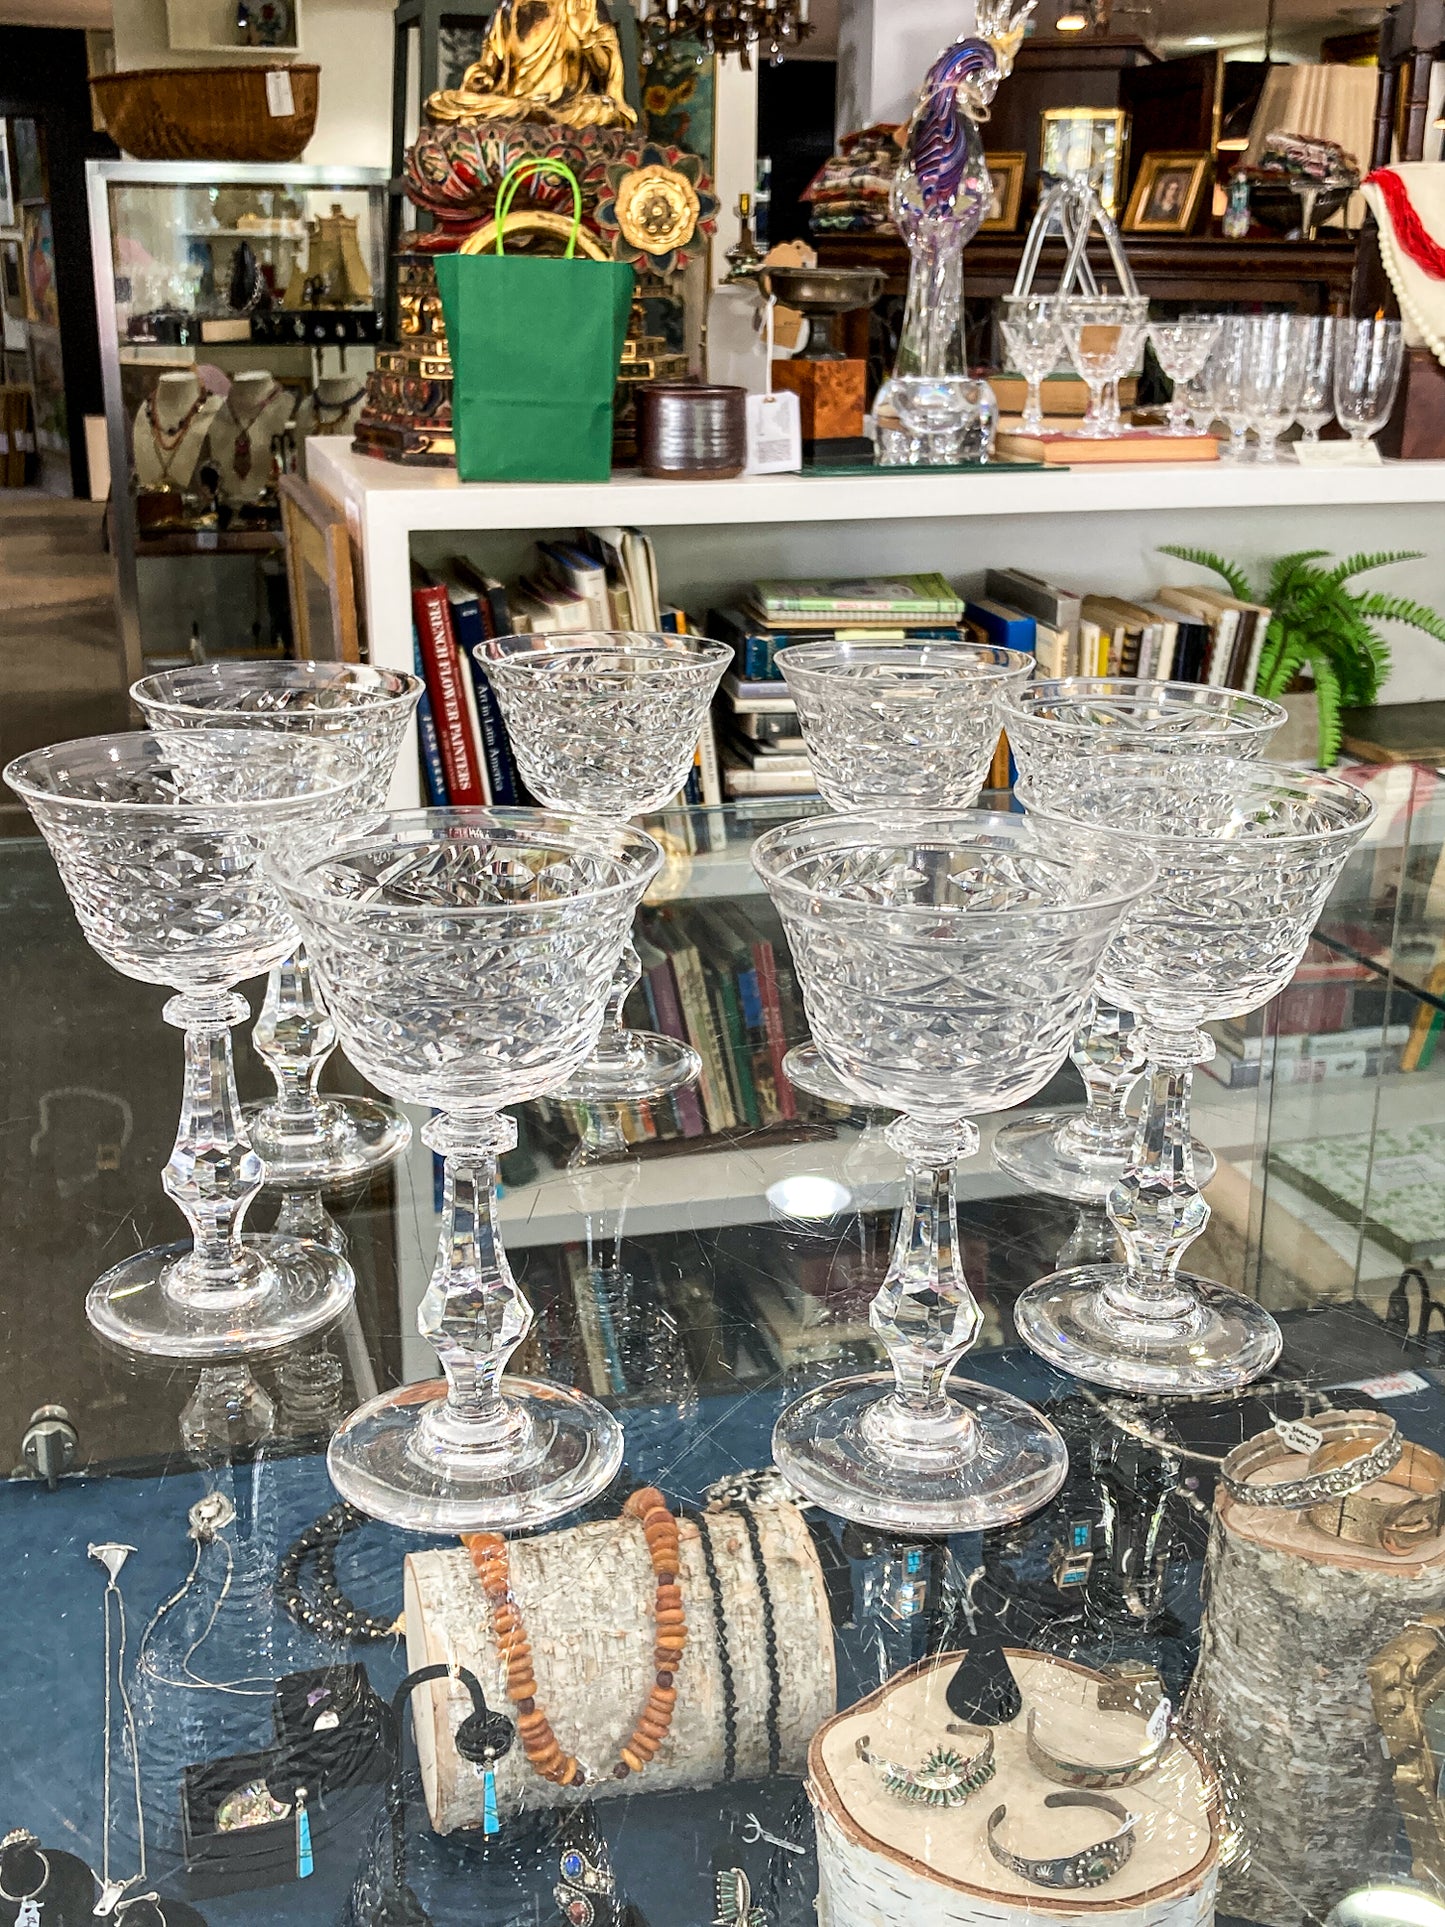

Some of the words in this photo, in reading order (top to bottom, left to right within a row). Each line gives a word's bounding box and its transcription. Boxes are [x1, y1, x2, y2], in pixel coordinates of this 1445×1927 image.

[428, 600, 449, 660] FRENCH
[439, 661, 459, 721] FLOWER
[450, 723, 471, 791] PAINTERS
[477, 684, 489, 703] Art
[481, 704, 492, 717] in
[423, 715, 438, 752] JACK
[484, 718, 496, 747] Latin
[488, 748, 504, 792] America
